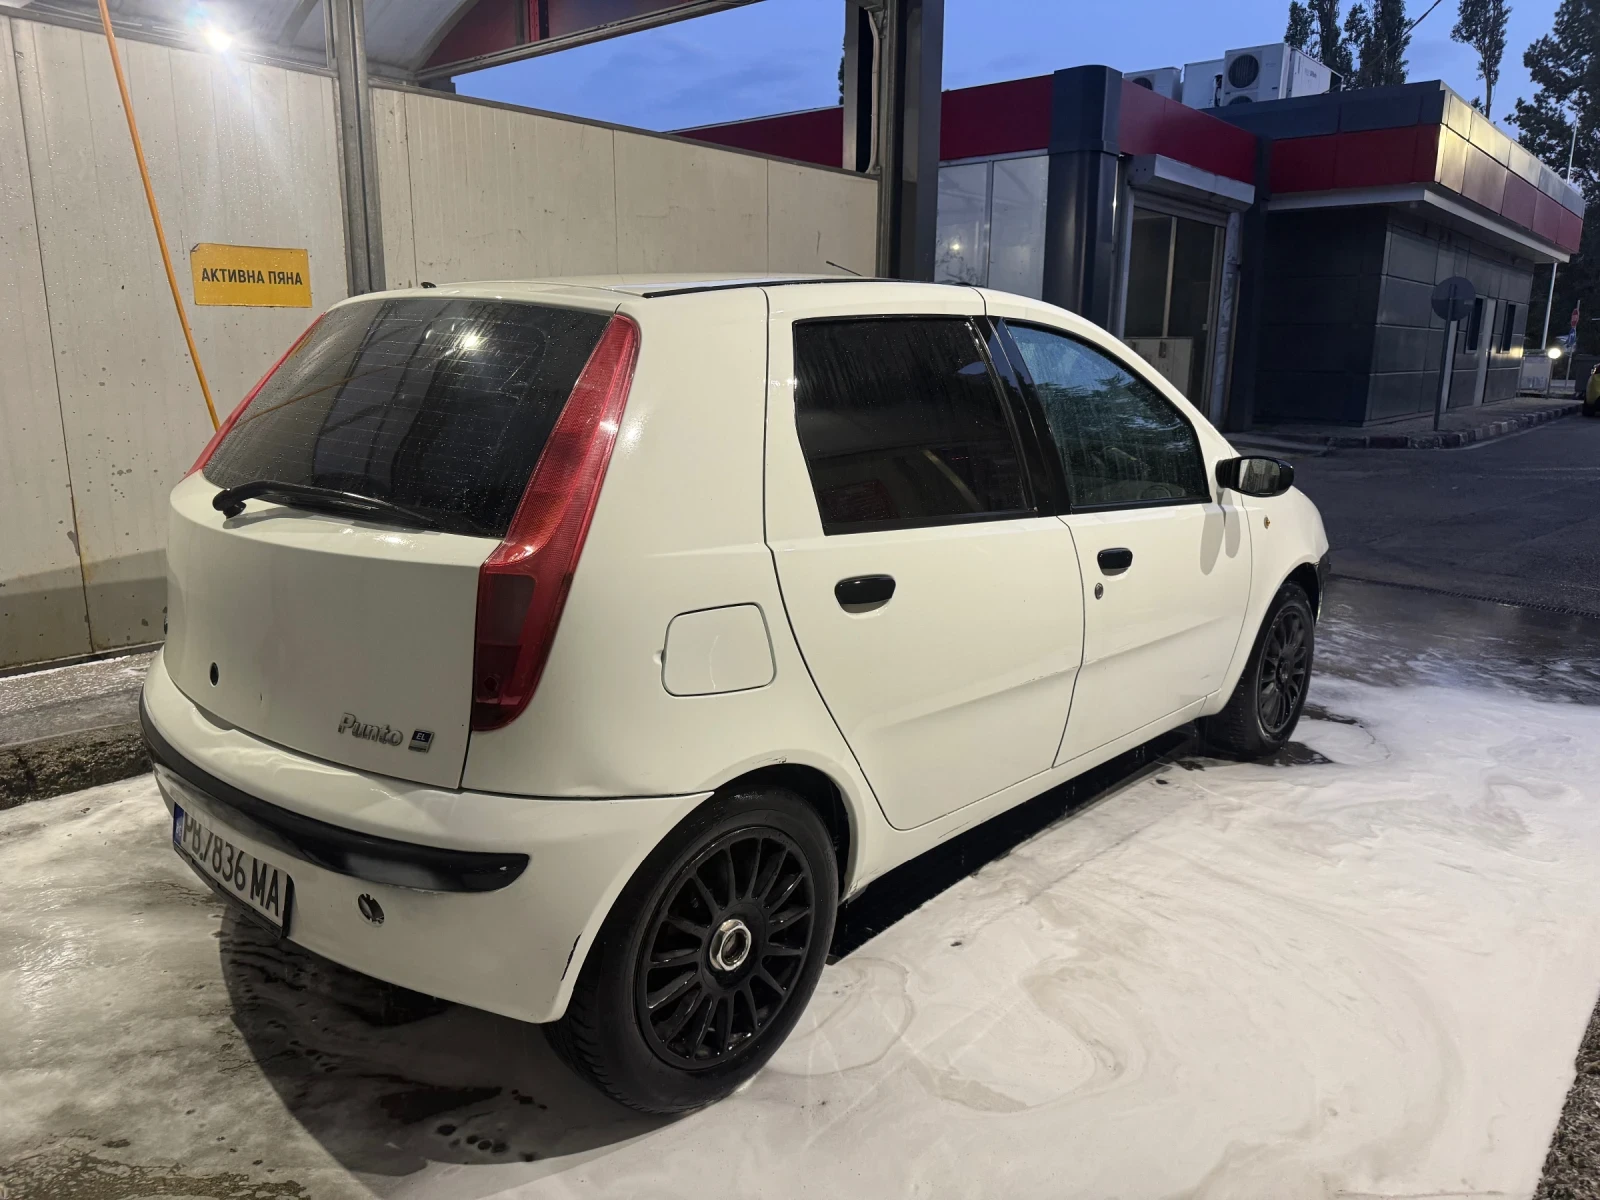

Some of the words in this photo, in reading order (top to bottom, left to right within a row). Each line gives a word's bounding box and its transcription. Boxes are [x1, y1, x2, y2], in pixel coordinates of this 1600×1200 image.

[202, 268, 265, 284] АКТИВНА
[268, 271, 303, 285] ПЯНА
[338, 712, 403, 746] Punto
